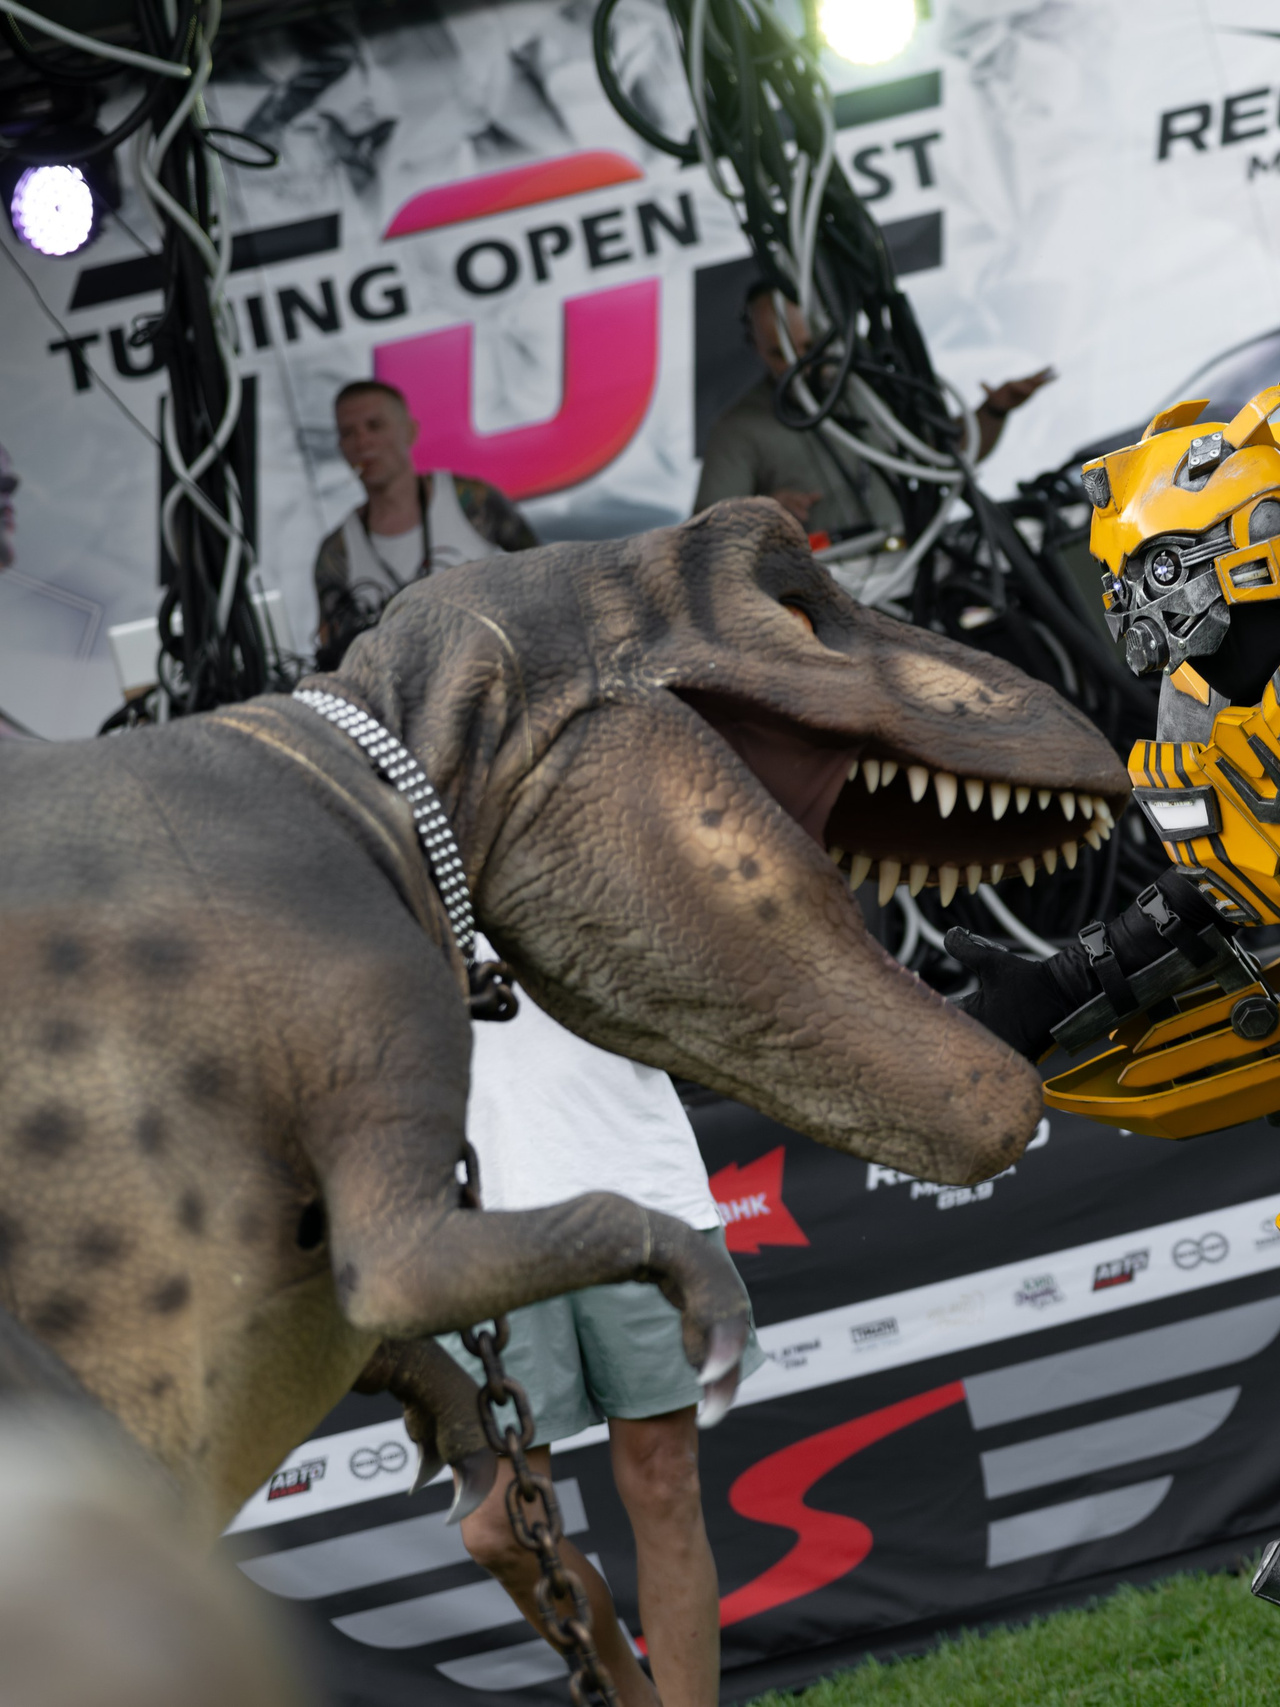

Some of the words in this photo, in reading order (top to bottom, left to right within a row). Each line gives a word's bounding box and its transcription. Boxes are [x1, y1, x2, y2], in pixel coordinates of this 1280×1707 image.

[47, 264, 409, 394] TUING
[454, 190, 700, 297] OPEN
[852, 131, 942, 202] ST
